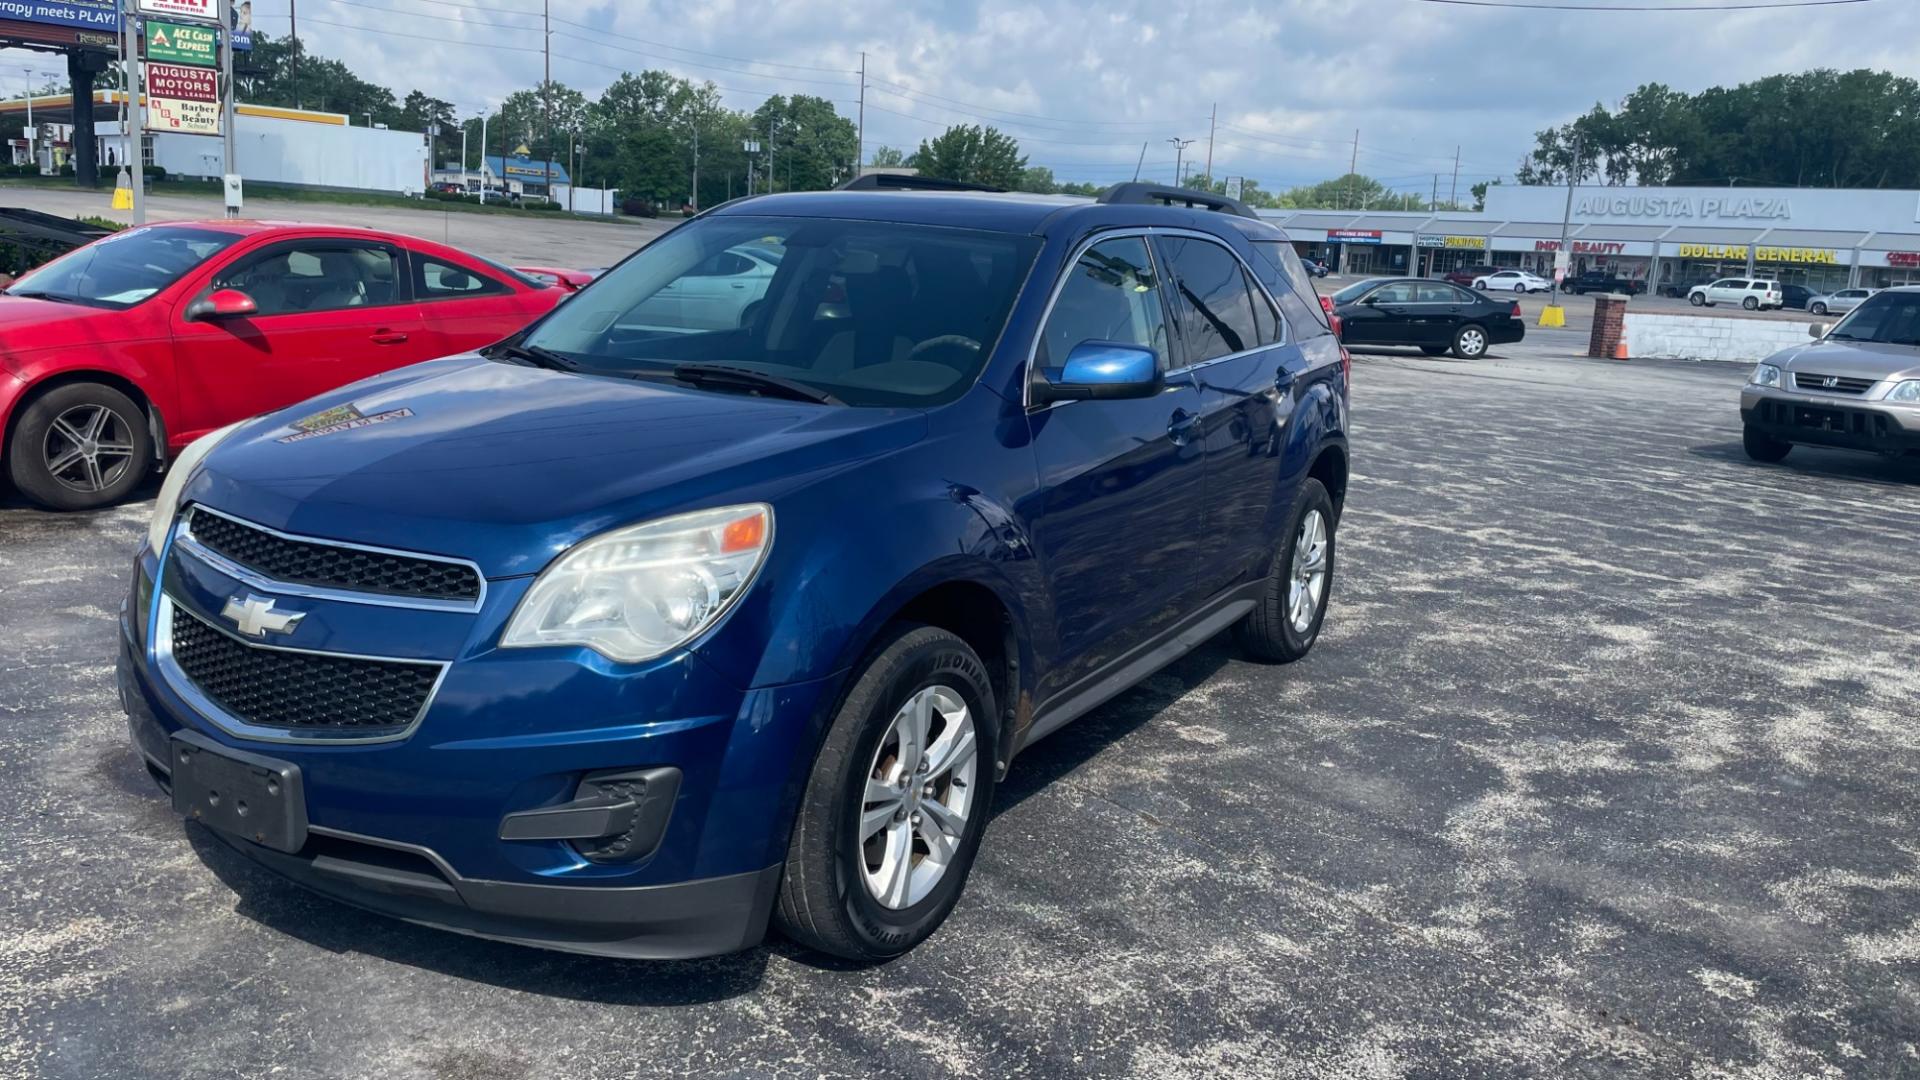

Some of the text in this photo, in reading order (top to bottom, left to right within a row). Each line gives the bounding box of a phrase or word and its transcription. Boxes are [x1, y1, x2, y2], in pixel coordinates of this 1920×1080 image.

[0, 2, 33, 18] rapy
[36, 6, 76, 20] meets
[79, 10, 116, 25] PLAY!
[152, 2, 206, 14] CARNICERIA
[173, 28, 191, 39] ACE
[192, 30, 214, 42] CASH
[177, 39, 210, 53] EXPRESS
[151, 66, 214, 81] AUGUSTA
[155, 78, 211, 92] MOTORS
[151, 88, 175, 96] SALES
[184, 91, 216, 100] LEASING
[181, 103, 215, 113] Barber
[181, 114, 216, 126] Beauty
[1575, 195, 1792, 220] AUGUSTA PLAZA
[1446, 236, 1485, 249] FURNITURE
[1535, 240, 1626, 254] INDY BEAUTY
[1678, 243, 1837, 265] DOLLAR GENERAL
